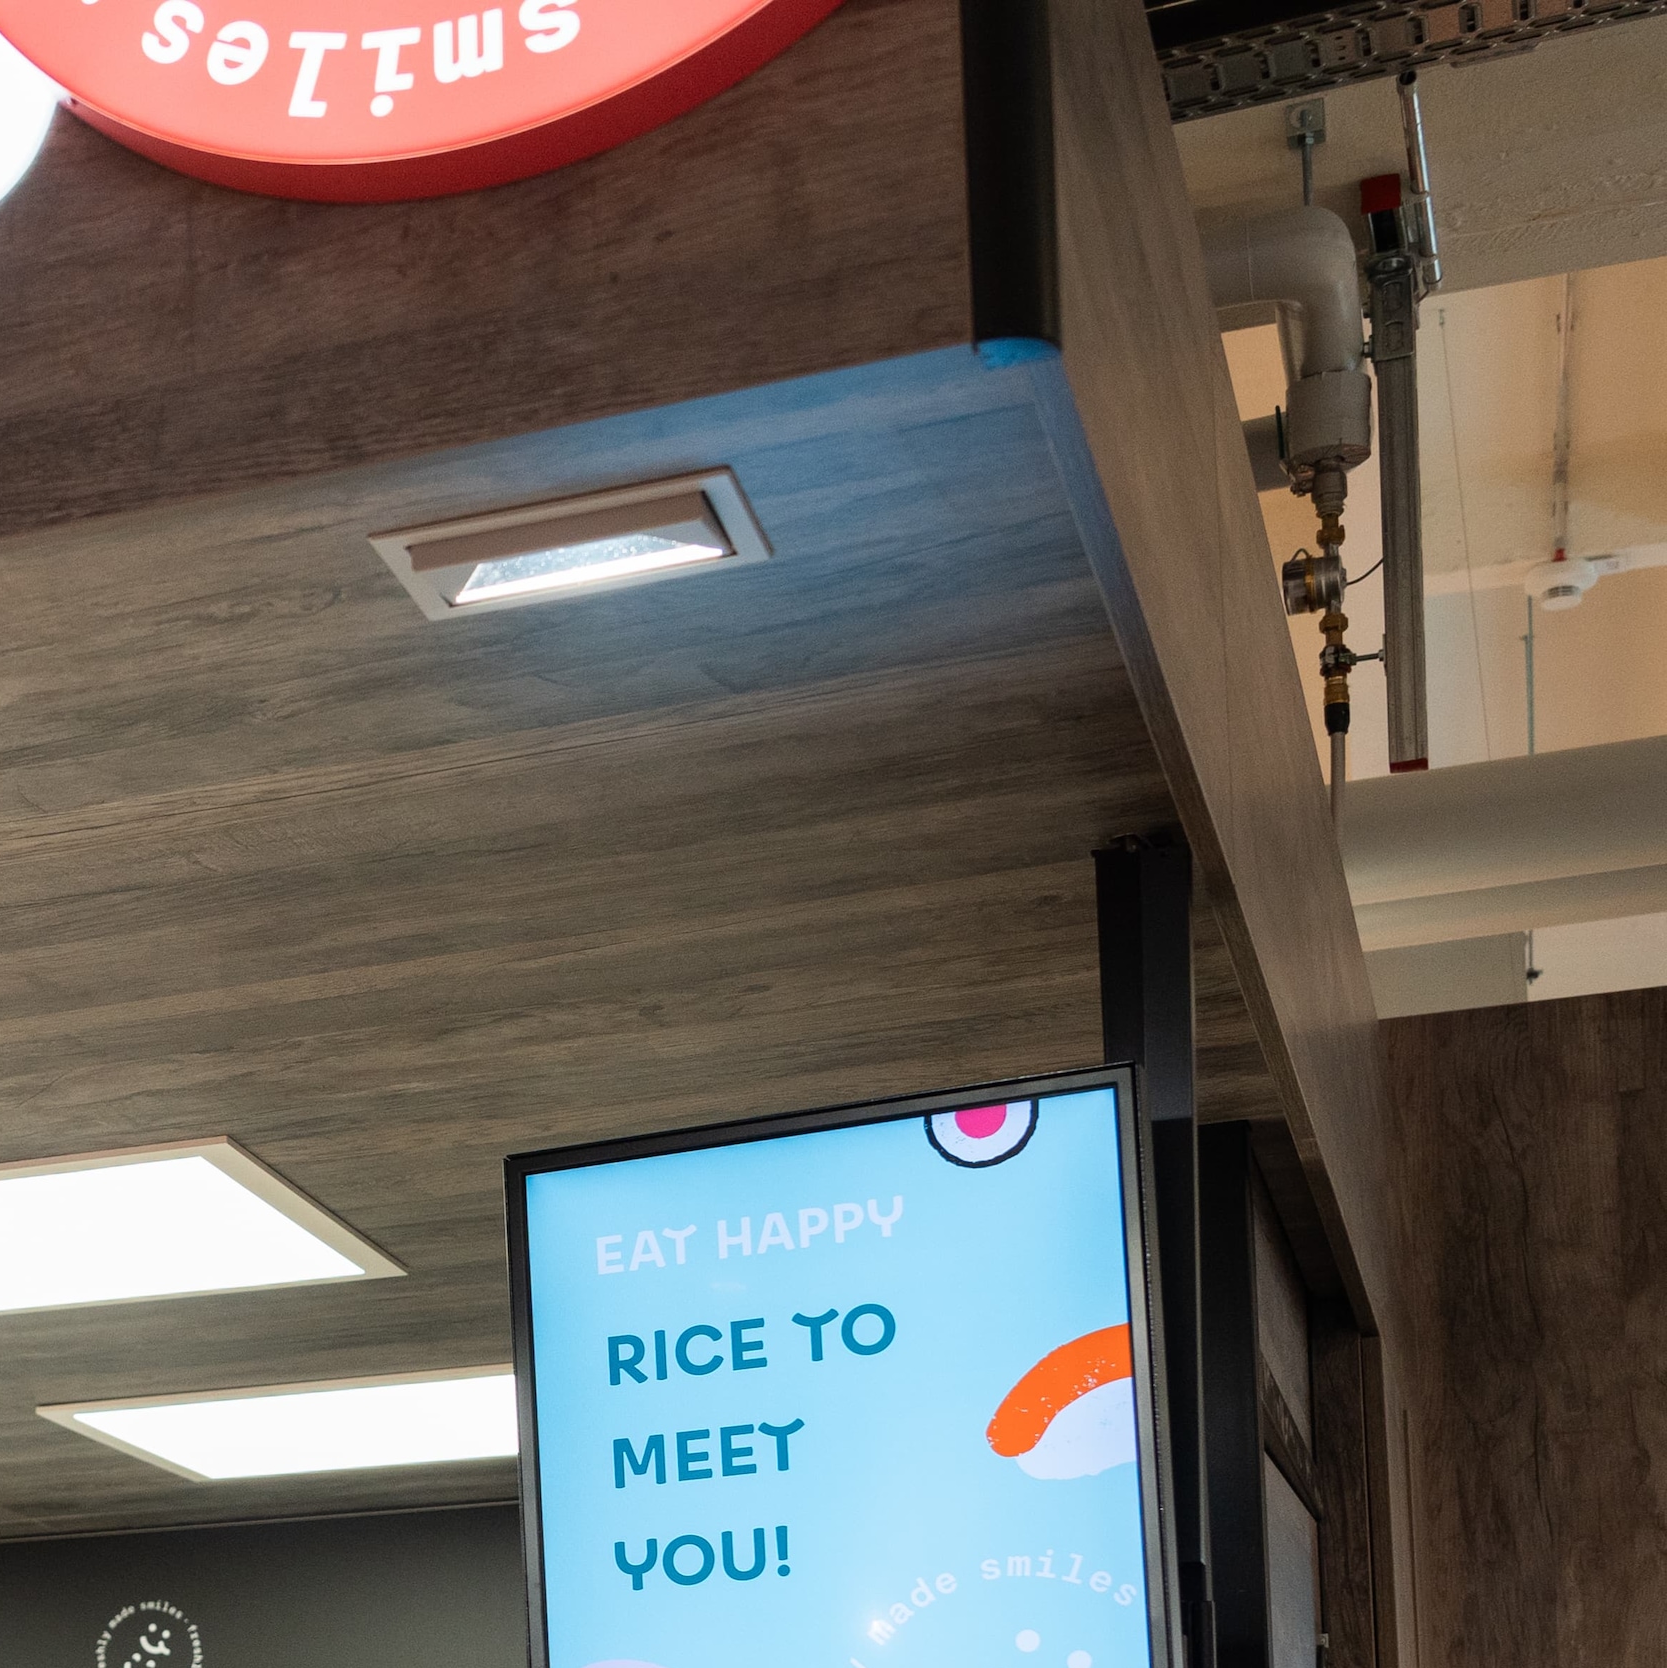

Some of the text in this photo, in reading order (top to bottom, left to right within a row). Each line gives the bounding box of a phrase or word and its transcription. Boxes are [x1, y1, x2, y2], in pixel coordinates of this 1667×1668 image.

[596, 1196, 904, 1276] EAT HAPPY
[607, 1303, 896, 1387] RICE TO
[612, 1418, 805, 1489] MEET
[614, 1525, 791, 1591] YOU!
[866, 1570, 959, 1648] made
[980, 1549, 1138, 1608] smiles
